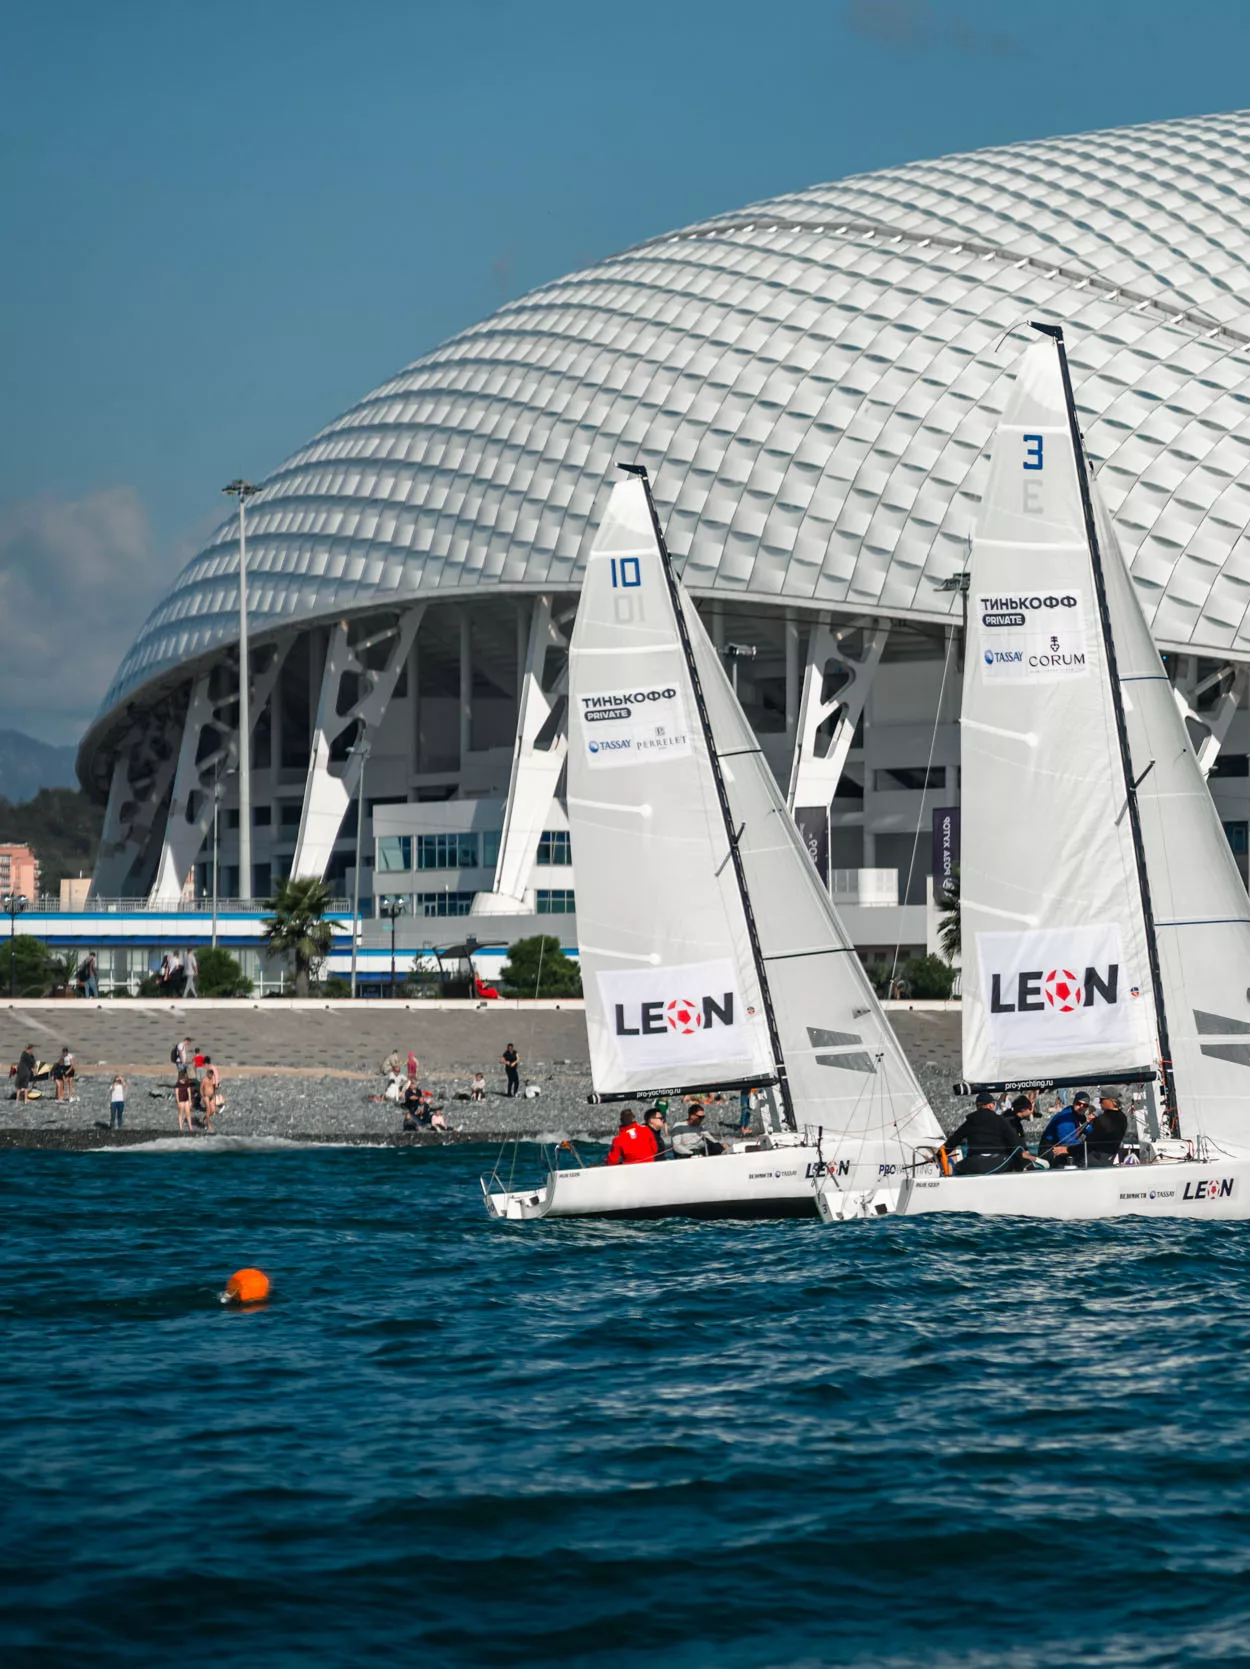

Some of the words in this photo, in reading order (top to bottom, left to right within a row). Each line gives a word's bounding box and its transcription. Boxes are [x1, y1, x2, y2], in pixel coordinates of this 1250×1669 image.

[1023, 434, 1043, 470] 3
[610, 557, 641, 588] 10
[981, 596, 1077, 612] ТИНЬКОФФ
[986, 615, 1023, 625] PRIVATE
[994, 651, 1023, 663] TASSAY
[1029, 652, 1086, 668] CORUM
[581, 688, 676, 708] ТИНЬКОФФ
[587, 710, 629, 721] PRIVATE
[600, 739, 632, 750] TASSAY
[636, 735, 687, 750] PERRELET
[991, 964, 1118, 1013] LEON
[615, 992, 734, 1036] LEON
[1004, 1078, 1054, 1091] pro-yachting.ru
[636, 1088, 681, 1099] pro-yachting.ru
[805, 1159, 850, 1179] LEON
[1183, 1178, 1234, 1201] LEON
[822, 1203, 829, 1215] 3
